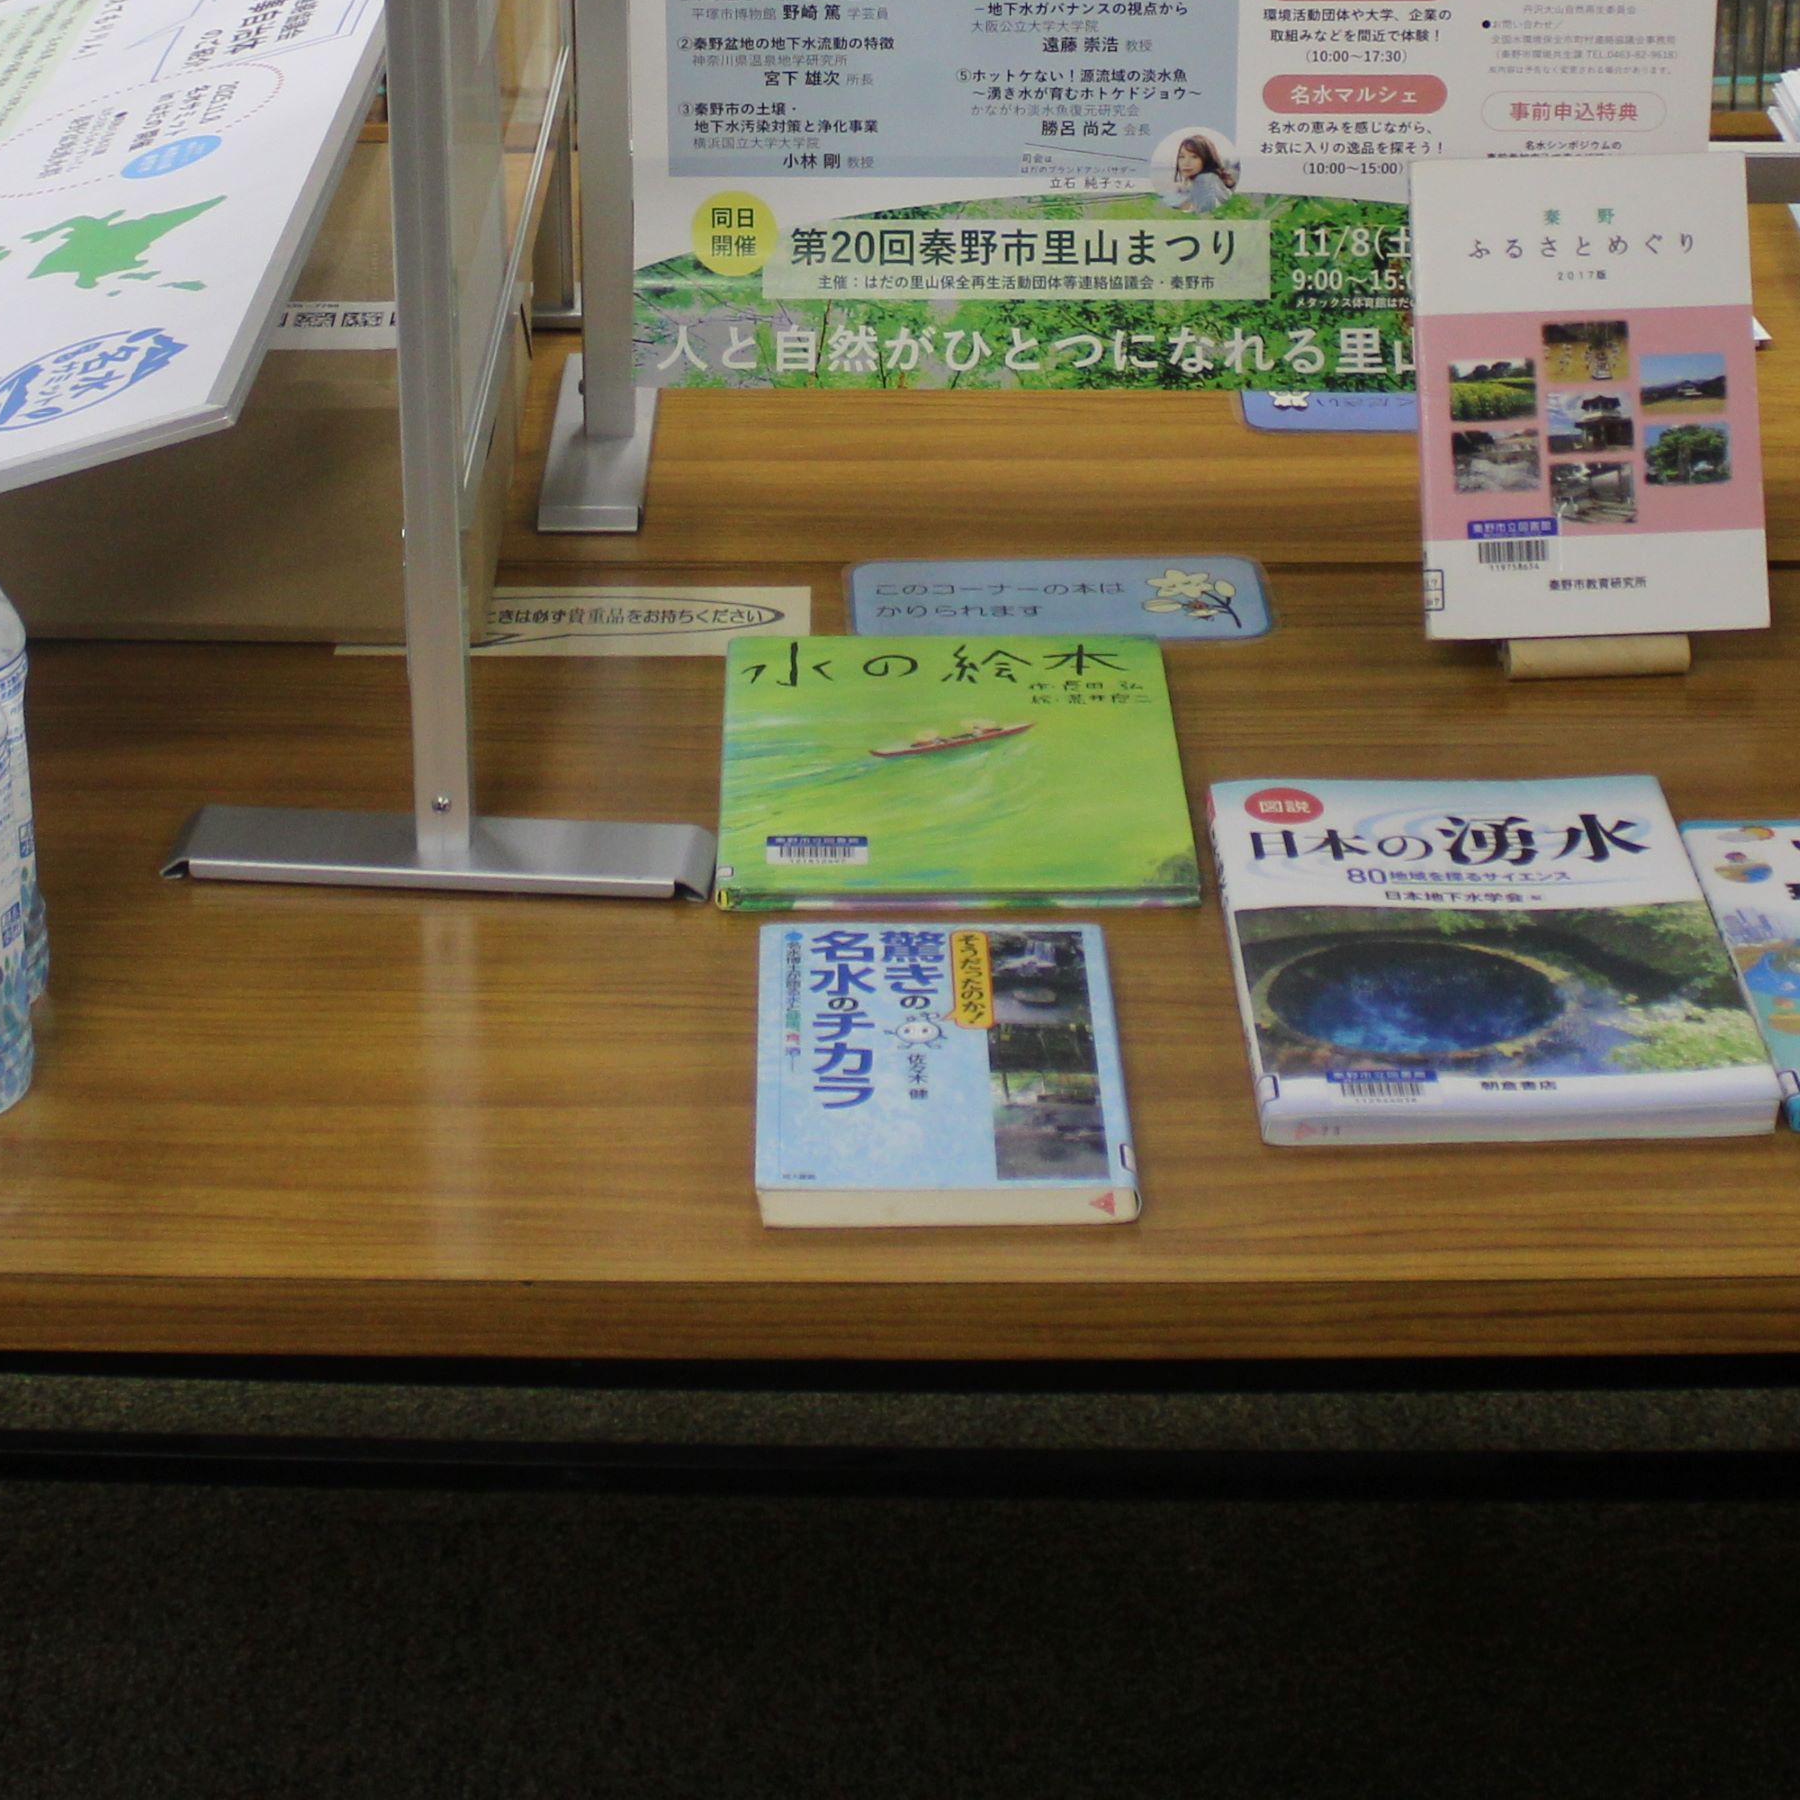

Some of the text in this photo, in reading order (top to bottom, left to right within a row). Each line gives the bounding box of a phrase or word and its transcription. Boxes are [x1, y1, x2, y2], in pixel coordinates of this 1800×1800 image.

[691, 7, 777, 21] 平塚市博物館
[847, 8, 888, 21] 学芸員
[1263, 8, 1452, 23] 環境活動団体や大学、企業の
[971, 19, 1099, 34] 大阪公立大学大学院
[1042, 36, 1153, 54] 遠藤 崇浩 教授
[692, 55, 848, 69] 神奈川県温泉地学研究所
[764, 70, 873, 88] 宮下 雄次 所長
[1290, 85, 1418, 105] 名水マルシェ
[1510, 102, 1639, 122] 事前申込特典
[694, 120, 878, 135] 地下水汚染対策と浄化事業
[1041, 120, 1151, 137] 勝呂 尚之 会長
[1267, 120, 1434, 136] 名水の恵みを感じながら、
[692, 137, 820, 150] 横浜国立大学大学院
[1525, 140, 1622, 151] 名水シンポジウムの
[783, 153, 874, 170] 小林 剛 教授
[711, 208, 755, 229] 同日
[711, 236, 757, 257] 開催
[790, 226, 1236, 267] 第20回秦野市里山まつり
[1469, 232, 1694, 260] ふるさとめぐり
[875, 582, 1126, 597] このコーナーの本は
[1549, 576, 1647, 591] 秦野市教育研究所
[875, 603, 1043, 619] かりられます
[741, 641, 1128, 686] 水の絵本
[1258, 799, 1311, 815] 図説
[1248, 813, 1652, 865] 日本の湧水
[1346, 867, 1572, 885] 80地域を探るサイエンス
[1385, 890, 1523, 903] 日本地下水学会
[879, 929, 947, 1011] 驚きの
[808, 929, 877, 1110] 名水のチカラ
[1480, 1080, 1558, 1092] 朝倉書店
